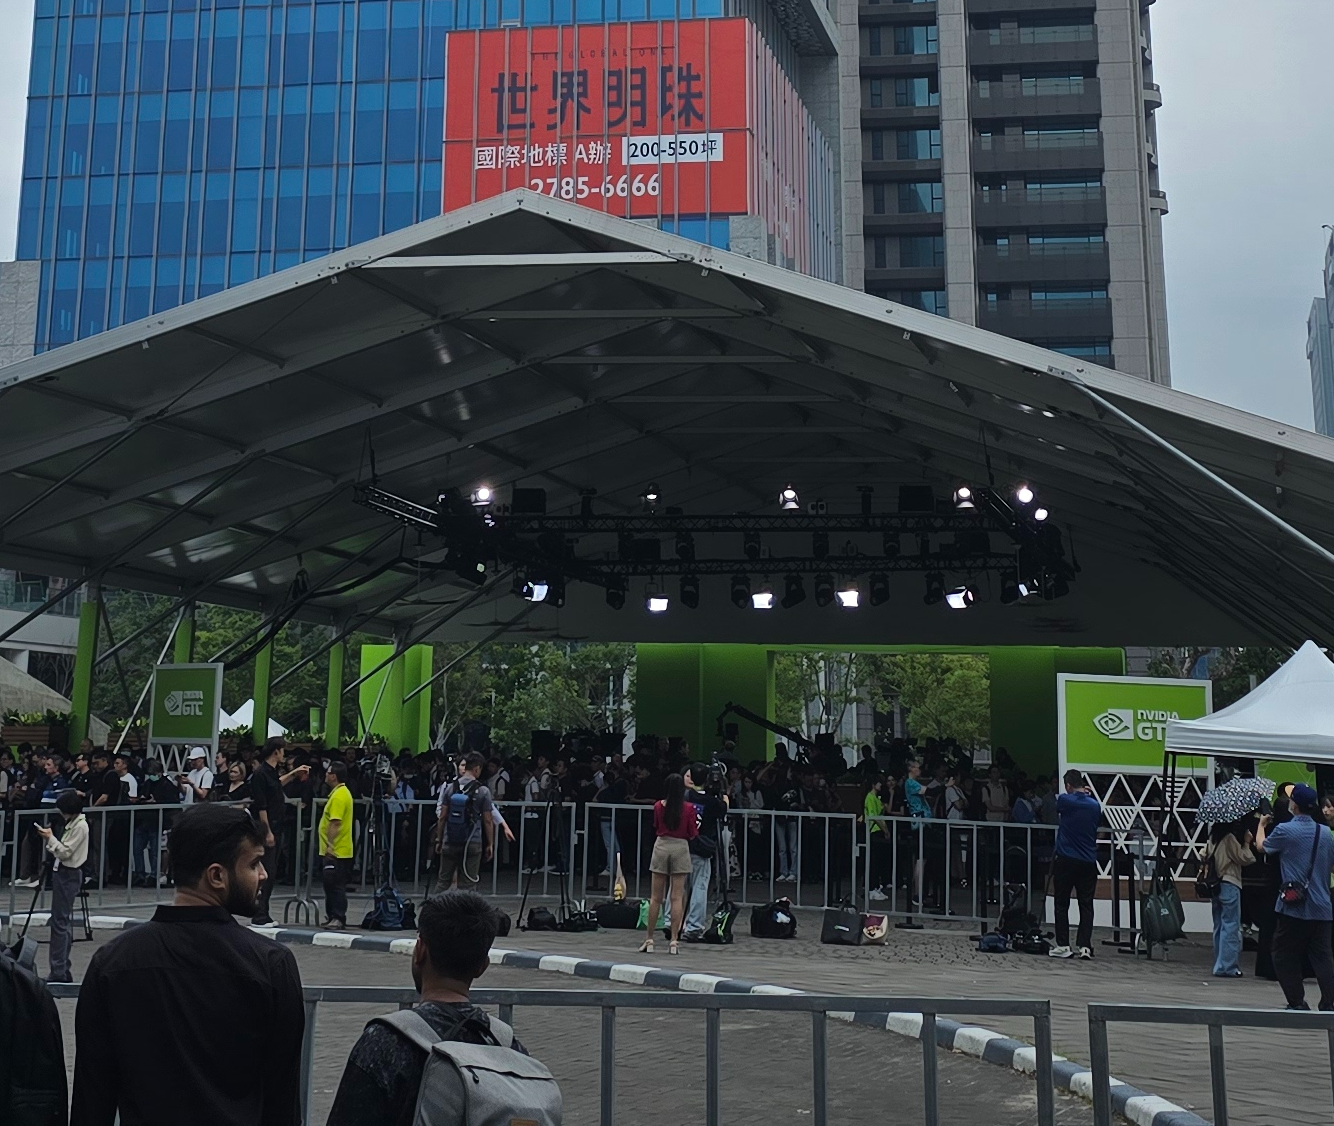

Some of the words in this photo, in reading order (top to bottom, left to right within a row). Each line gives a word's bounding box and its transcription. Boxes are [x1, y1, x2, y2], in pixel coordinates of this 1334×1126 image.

[491, 63, 704, 134] 世界明珠
[475, 144, 568, 169] 國際地標
[629, 139, 718, 158] 200-550坪
[530, 173, 659, 200] 2785-6666
[182, 701, 203, 716] GTC
[1137, 709, 1180, 721] NVIDIA
[1137, 722, 1167, 741] GT
